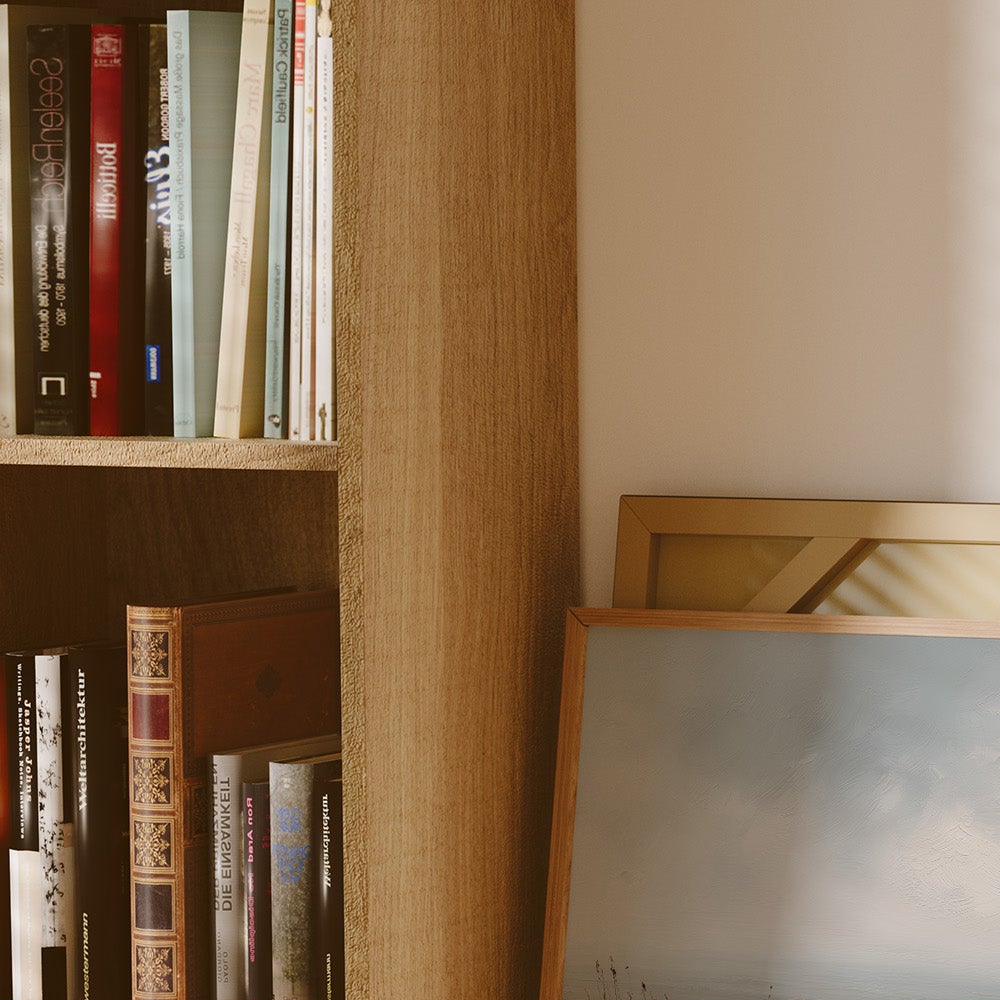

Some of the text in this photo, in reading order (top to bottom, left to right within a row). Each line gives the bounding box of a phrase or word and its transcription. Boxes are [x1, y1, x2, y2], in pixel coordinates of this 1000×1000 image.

[23, 700, 33, 802] Jasper Johns
[77, 669, 87, 811] Weltarchitektur
